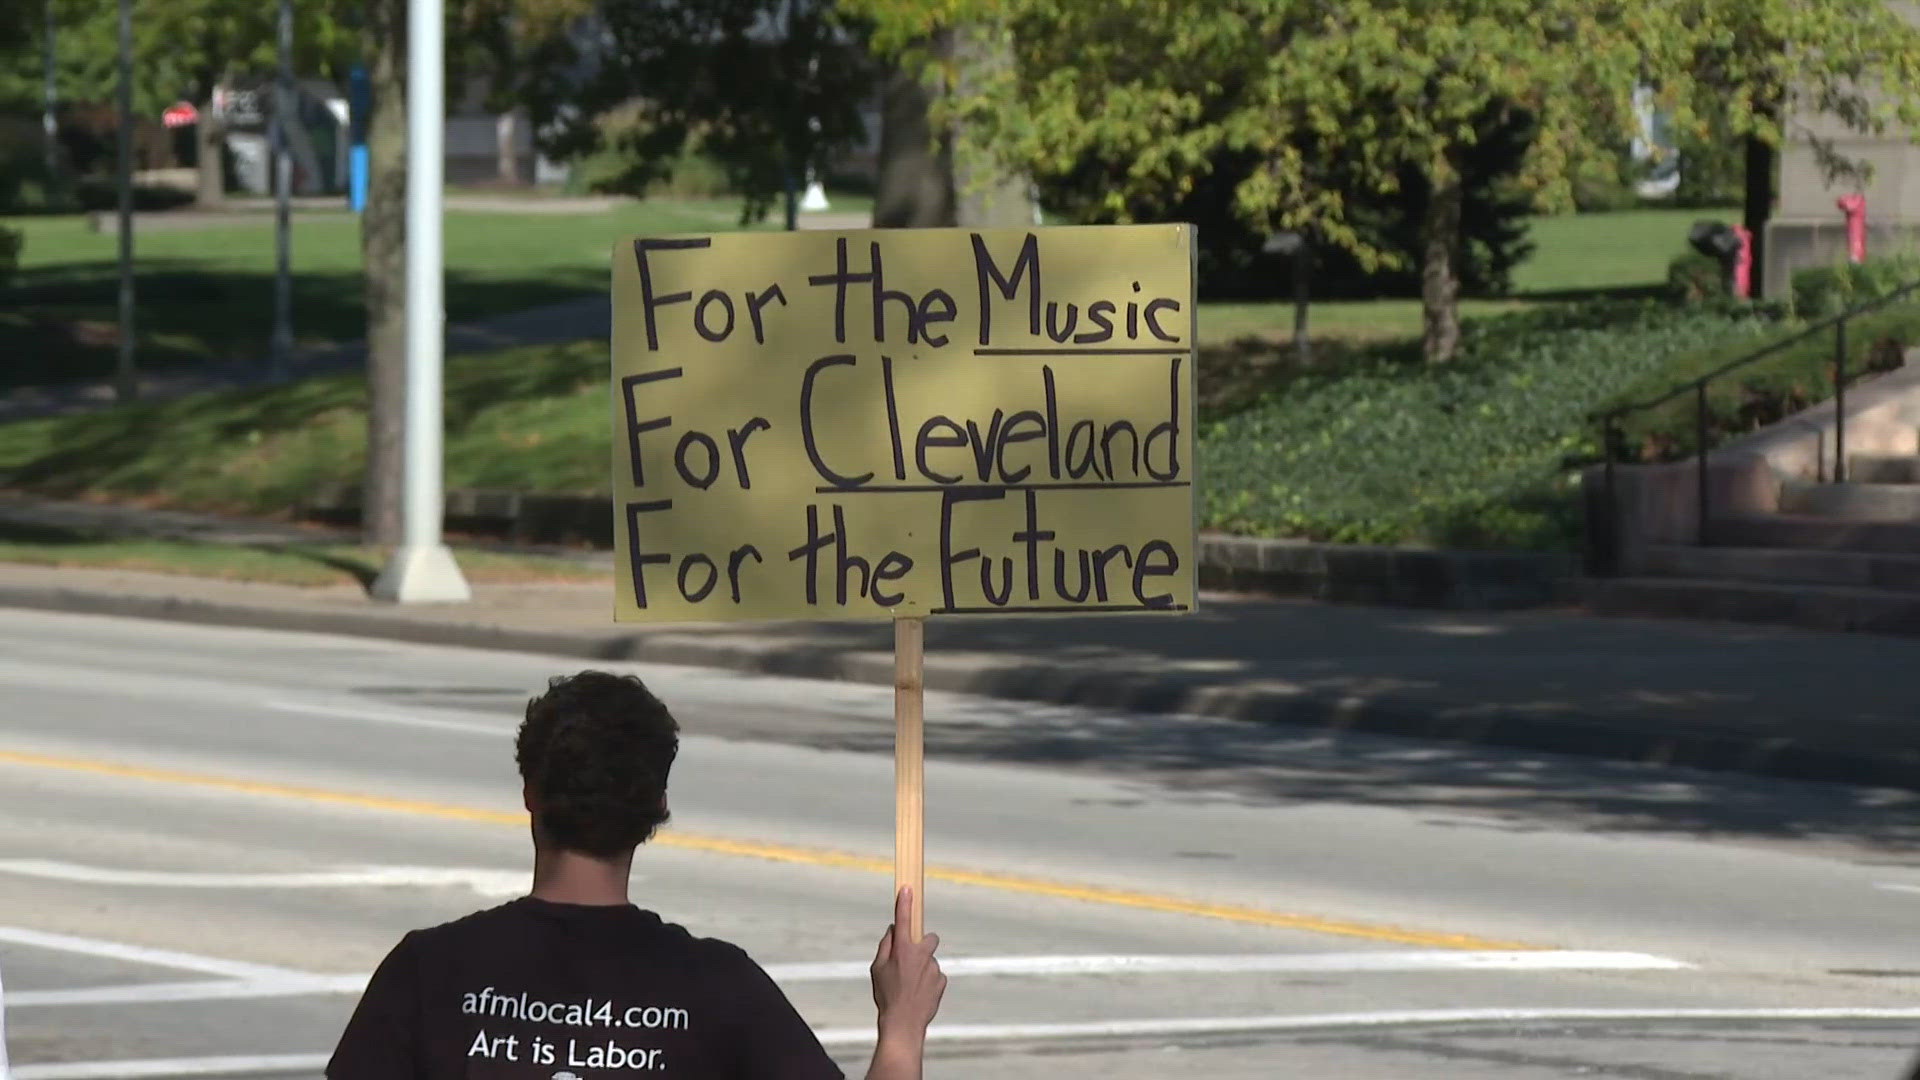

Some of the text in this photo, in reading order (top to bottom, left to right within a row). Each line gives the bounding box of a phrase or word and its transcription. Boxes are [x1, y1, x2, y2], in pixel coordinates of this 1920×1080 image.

[634, 232, 1181, 352] For the Music
[621, 354, 1182, 490] For Cleveland
[626, 488, 1180, 609] For the Future
[462, 986, 688, 1030] afmlocal4.com
[468, 1030, 666, 1070] Art is Labor.
